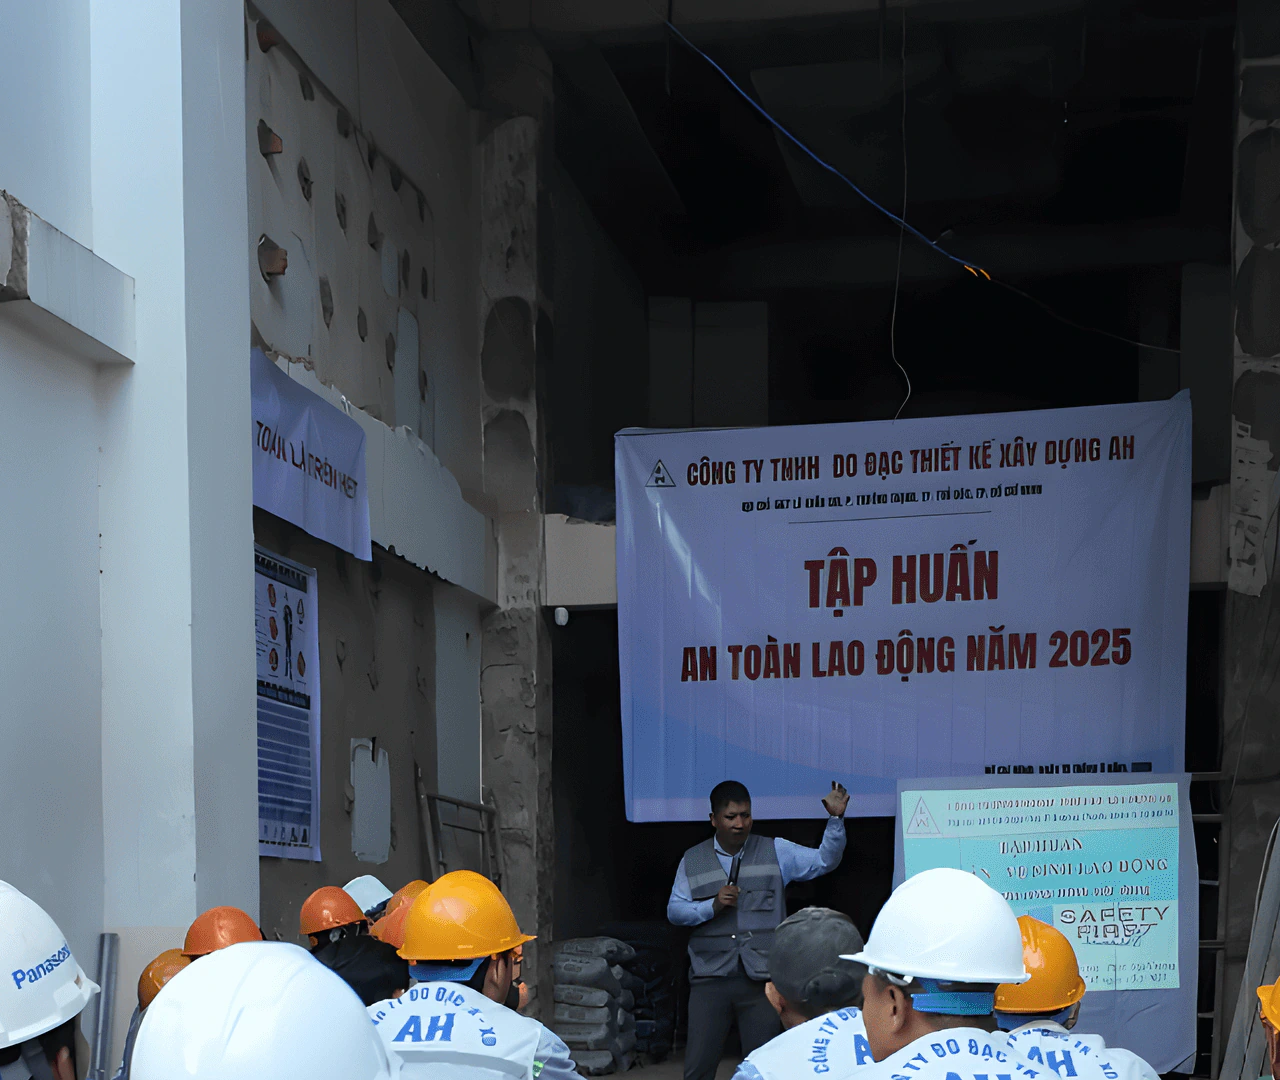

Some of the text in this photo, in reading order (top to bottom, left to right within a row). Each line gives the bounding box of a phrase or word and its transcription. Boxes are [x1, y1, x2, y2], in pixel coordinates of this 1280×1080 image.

[687, 455, 736, 486] CÔNG
[743, 459, 764, 483] TY
[770, 455, 820, 481] TNHH
[910, 441, 962, 474] THIẾT
[1044, 437, 1101, 469] DỰNG
[1109, 435, 1135, 461] AH
[804, 539, 999, 617] TẬP HUẤN
[681, 624, 1132, 682] AN TOÀN LAO ĐỘNG NĂM 2025
[1060, 905, 1170, 924] SAFETY
[393, 1013, 455, 1042] AH
[903, 1053, 928, 1070] TY
[931, 1039, 960, 1057] ĐO
[968, 1039, 1007, 1062] ĐẠC
